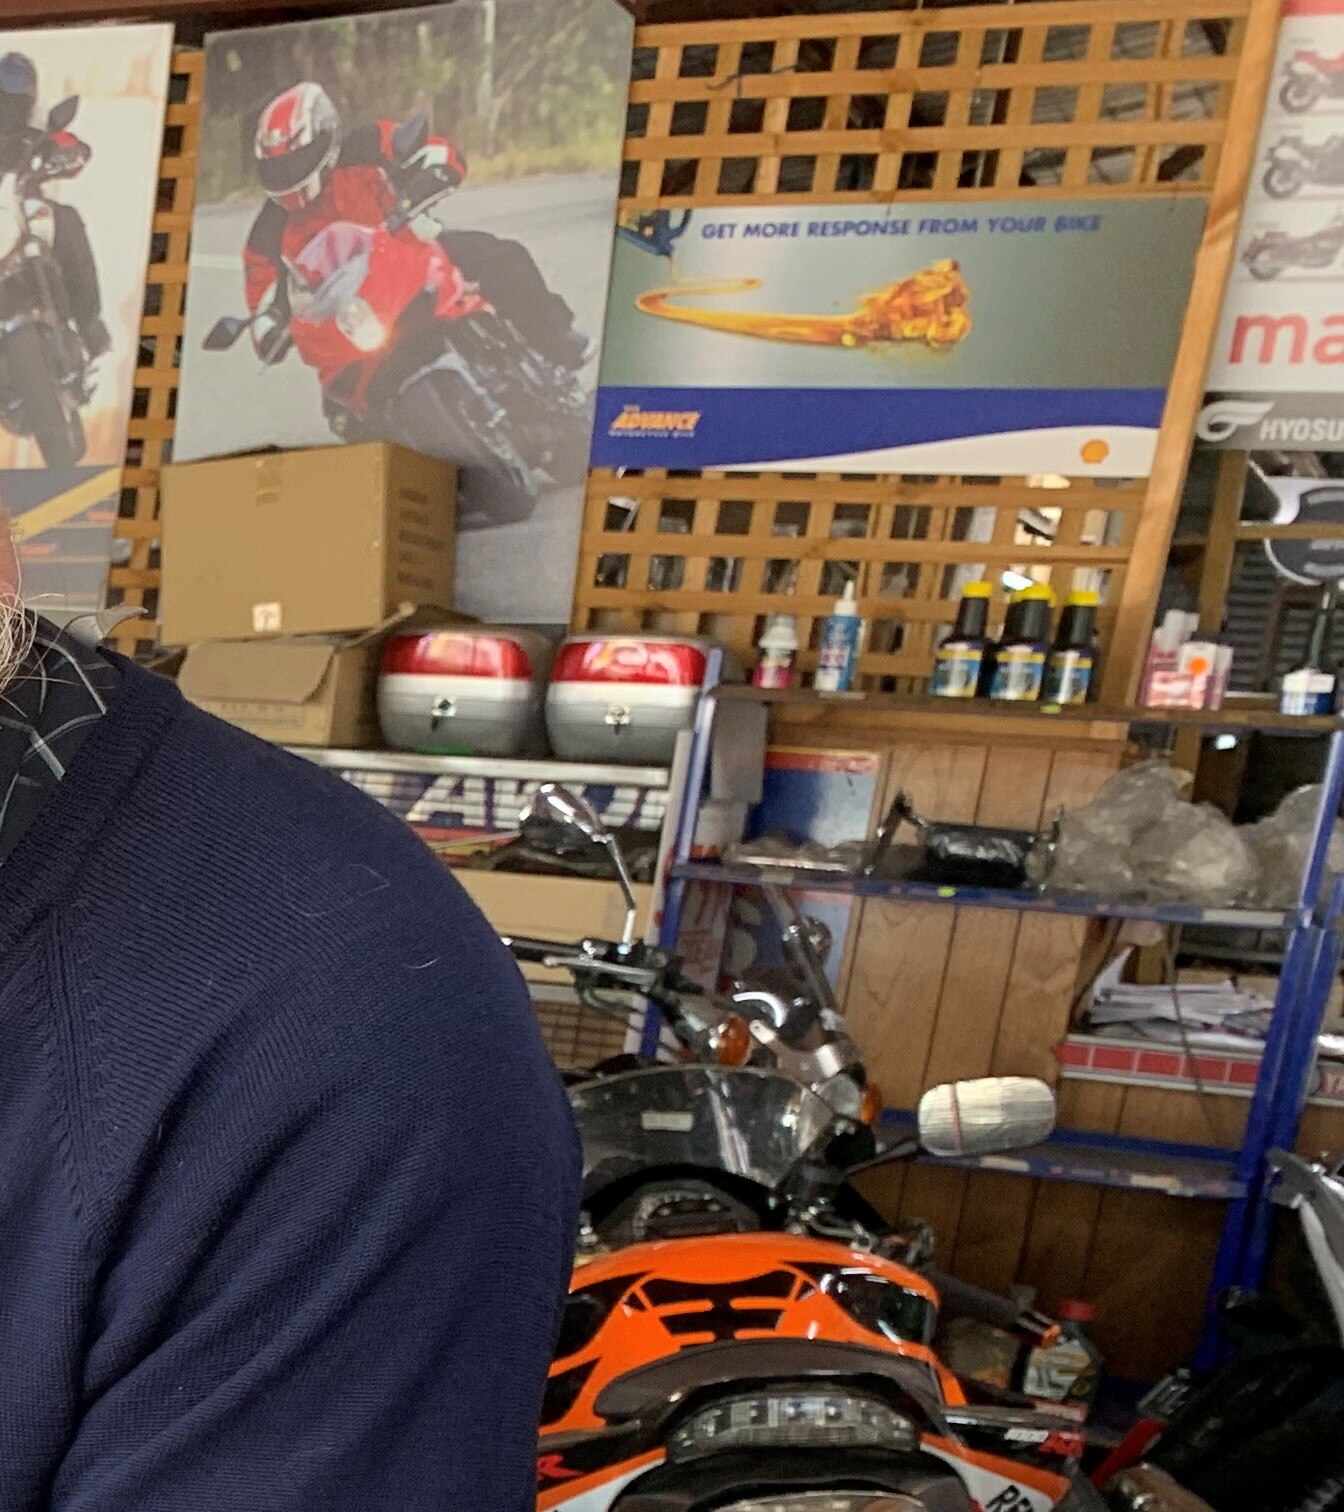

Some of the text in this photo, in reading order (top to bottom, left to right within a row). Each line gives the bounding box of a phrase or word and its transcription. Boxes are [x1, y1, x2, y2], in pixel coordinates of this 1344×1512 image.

[701, 214, 1102, 239] GET MORE RESPONSE FROM YOUR BIKE
